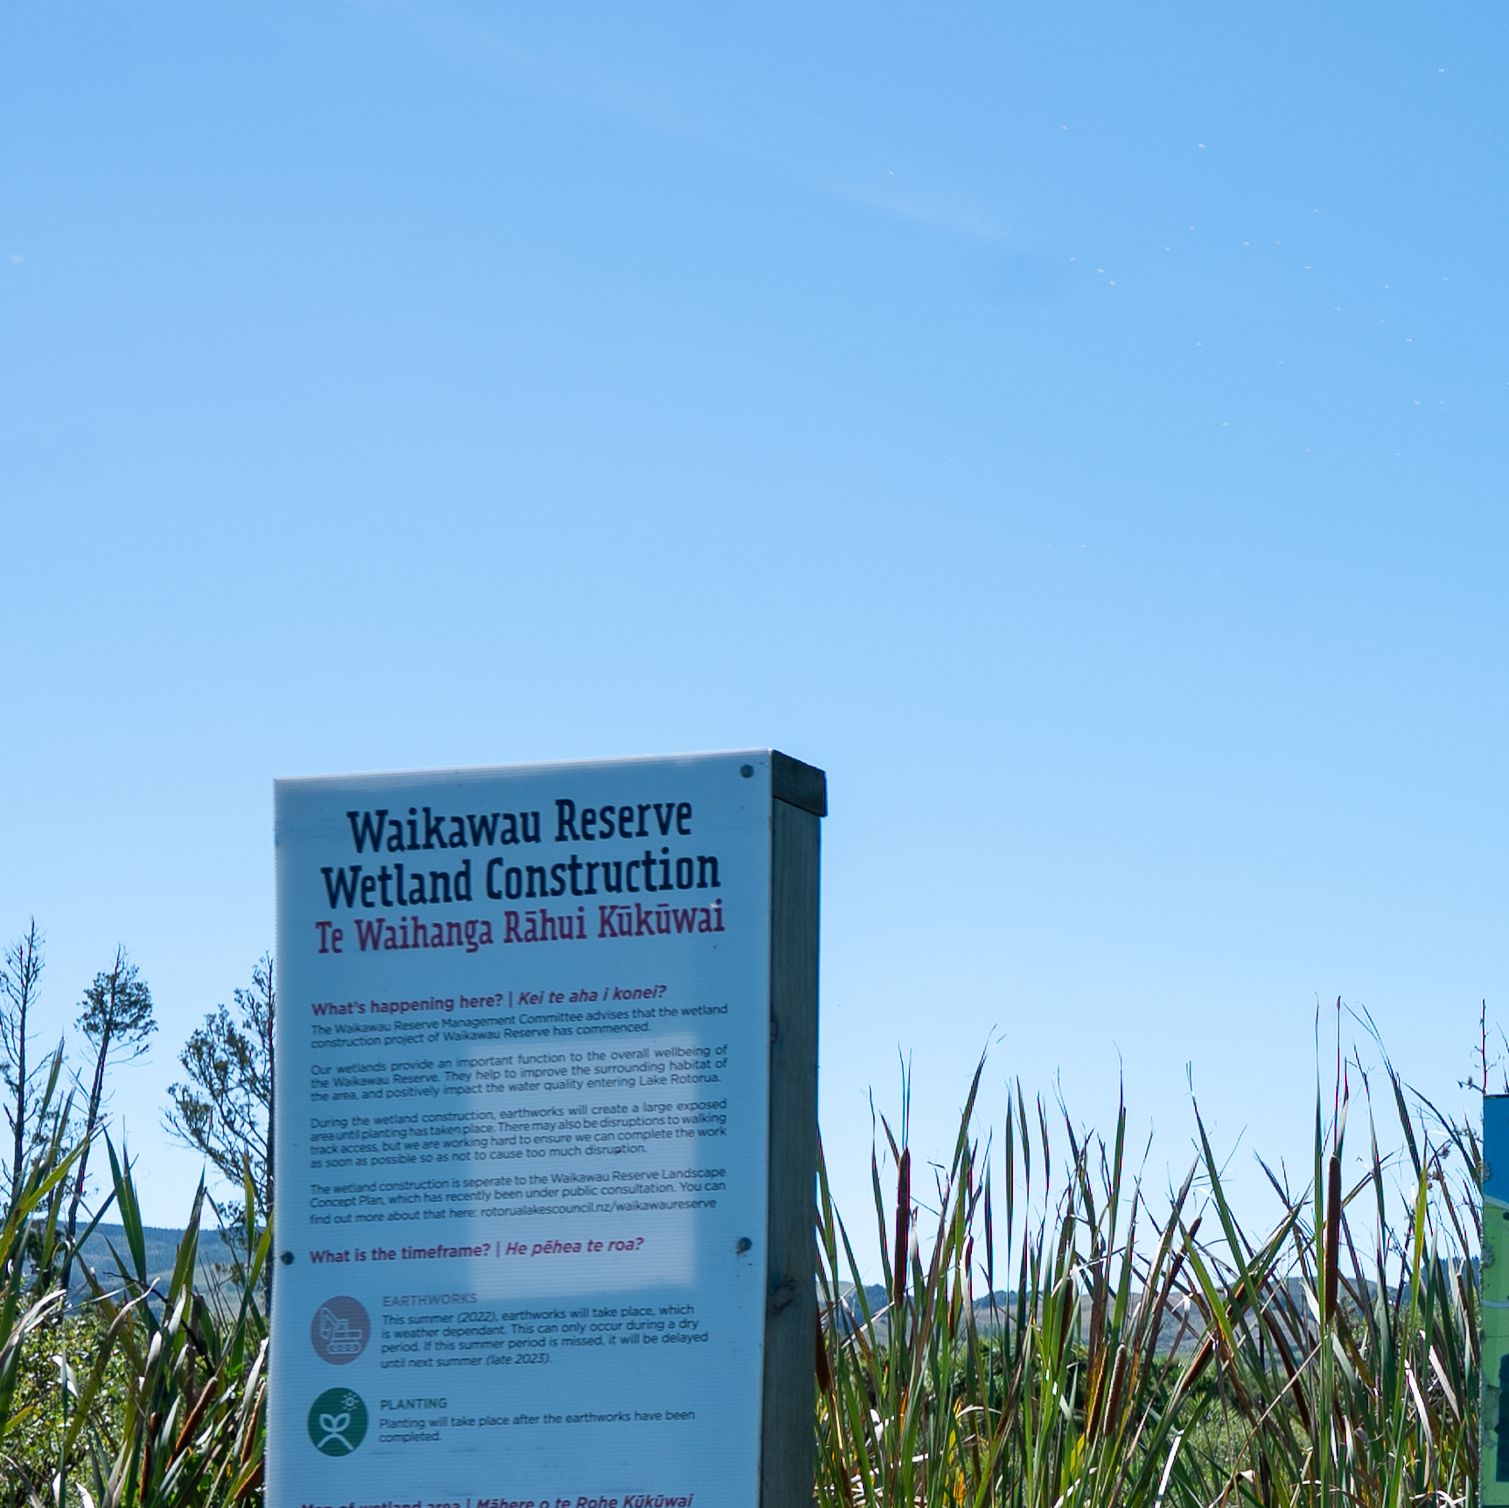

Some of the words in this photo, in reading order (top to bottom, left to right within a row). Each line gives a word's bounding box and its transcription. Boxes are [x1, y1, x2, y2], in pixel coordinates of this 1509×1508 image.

[347, 806, 542, 853] Waikawau
[554, 799, 693, 842] Reserve
[321, 858, 473, 909] Wetland
[485, 847, 721, 901] Construction
[315, 920, 344, 953] Te
[354, 916, 494, 953] Waihanga
[503, 906, 587, 944] Rāhui
[597, 898, 726, 938] Kūkūwai
[312, 999, 366, 1014] What's
[370, 995, 455, 1015] happening
[459, 993, 503, 1008] here?
[518, 991, 544, 1005] Kei
[548, 990, 565, 1004] te
[568, 988, 598, 1003] aha
[602, 988, 608, 1001] i
[612, 985, 666, 1001] konei?
[312, 1022, 332, 1033] The
[334, 1019, 392, 1032] Waikawau
[393, 1017, 440, 1030] Reserve
[441, 1014, 516, 1030] Management
[518, 1011, 583, 1024] Committee
[585, 1008, 630, 1021] advises
[631, 1007, 656, 1019] that
[658, 1006, 678, 1017] the
[680, 1004, 728, 1016] wetland
[310, 1033, 382, 1047] construction
[383, 1031, 424, 1046] project
[427, 1031, 440, 1042] of
[442, 1028, 501, 1041] Waikawau
[502, 1026, 551, 1038] Reserve
[552, 1025, 574, 1036] has
[575, 1021, 651, 1035] commenced.
[309, 1212, 332, 1223] find
[333, 1211, 352, 1222] out
[354, 1212, 384, 1221] more
[386, 1209, 420, 1220] about
[422, 1208, 446, 1219] that
[448, 1206, 478, 1218] here:
[310, 1248, 350, 1262] What
[354, 1248, 366, 1261] is
[371, 1246, 396, 1260] the
[401, 1243, 490, 1259] timeframe?
[505, 1241, 527, 1255] He
[530, 1238, 582, 1257] pēhea
[586, 1238, 603, 1252] te
[607, 1237, 644, 1251] roa?
[381, 1293, 478, 1306] EARTHWORKS
[382, 1313, 405, 1324] This
[407, 1314, 454, 1323] summer
[501, 1308, 566, 1320] earthworks
[569, 1307, 590, 1318] will
[591, 1306, 618, 1318] take
[619, 1305, 656, 1319] place,
[658, 1304, 695, 1316] which
[381, 1326, 391, 1337] is
[393, 1325, 439, 1337] weather
[511, 1323, 535, 1334] This
[536, 1324, 559, 1333] can
[560, 1321, 587, 1335] only
[589, 1323, 622, 1332] occur
[625, 1319, 665, 1333] during
[667, 1321, 676, 1330] a
[677, 1318, 699, 1332] dry
[380, 1340, 420, 1353] period.
[423, 1339, 432, 1350] If
[434, 1339, 456, 1349] this
[458, 1340, 504, 1349] summer
[507, 1336, 547, 1350] period
[547, 1336, 558, 1346] is
[560, 1335, 605, 1348] missed,
[608, 1334, 616, 1345] it
[619, 1334, 640, 1344] will
[641, 1333, 658, 1344] be
[660, 1332, 709, 1346] delayed
[380, 1357, 406, 1367] until
[407, 1356, 434, 1367] next
[435, 1357, 482, 1366] summer
[379, 1398, 447, 1409] PLANTING
[378, 1416, 426, 1430] Planting
[428, 1416, 448, 1426] will
[450, 1415, 476, 1426] take
[477, 1414, 510, 1427] place
[512, 1413, 539, 1424] after
[542, 1413, 563, 1423] the
[564, 1411, 631, 1423] earthworks
[633, 1410, 663, 1421] have
[664, 1409, 695, 1420] been
[379, 1430, 441, 1444] completed.
[622, 1493, 692, 1508] Kūkūwai
